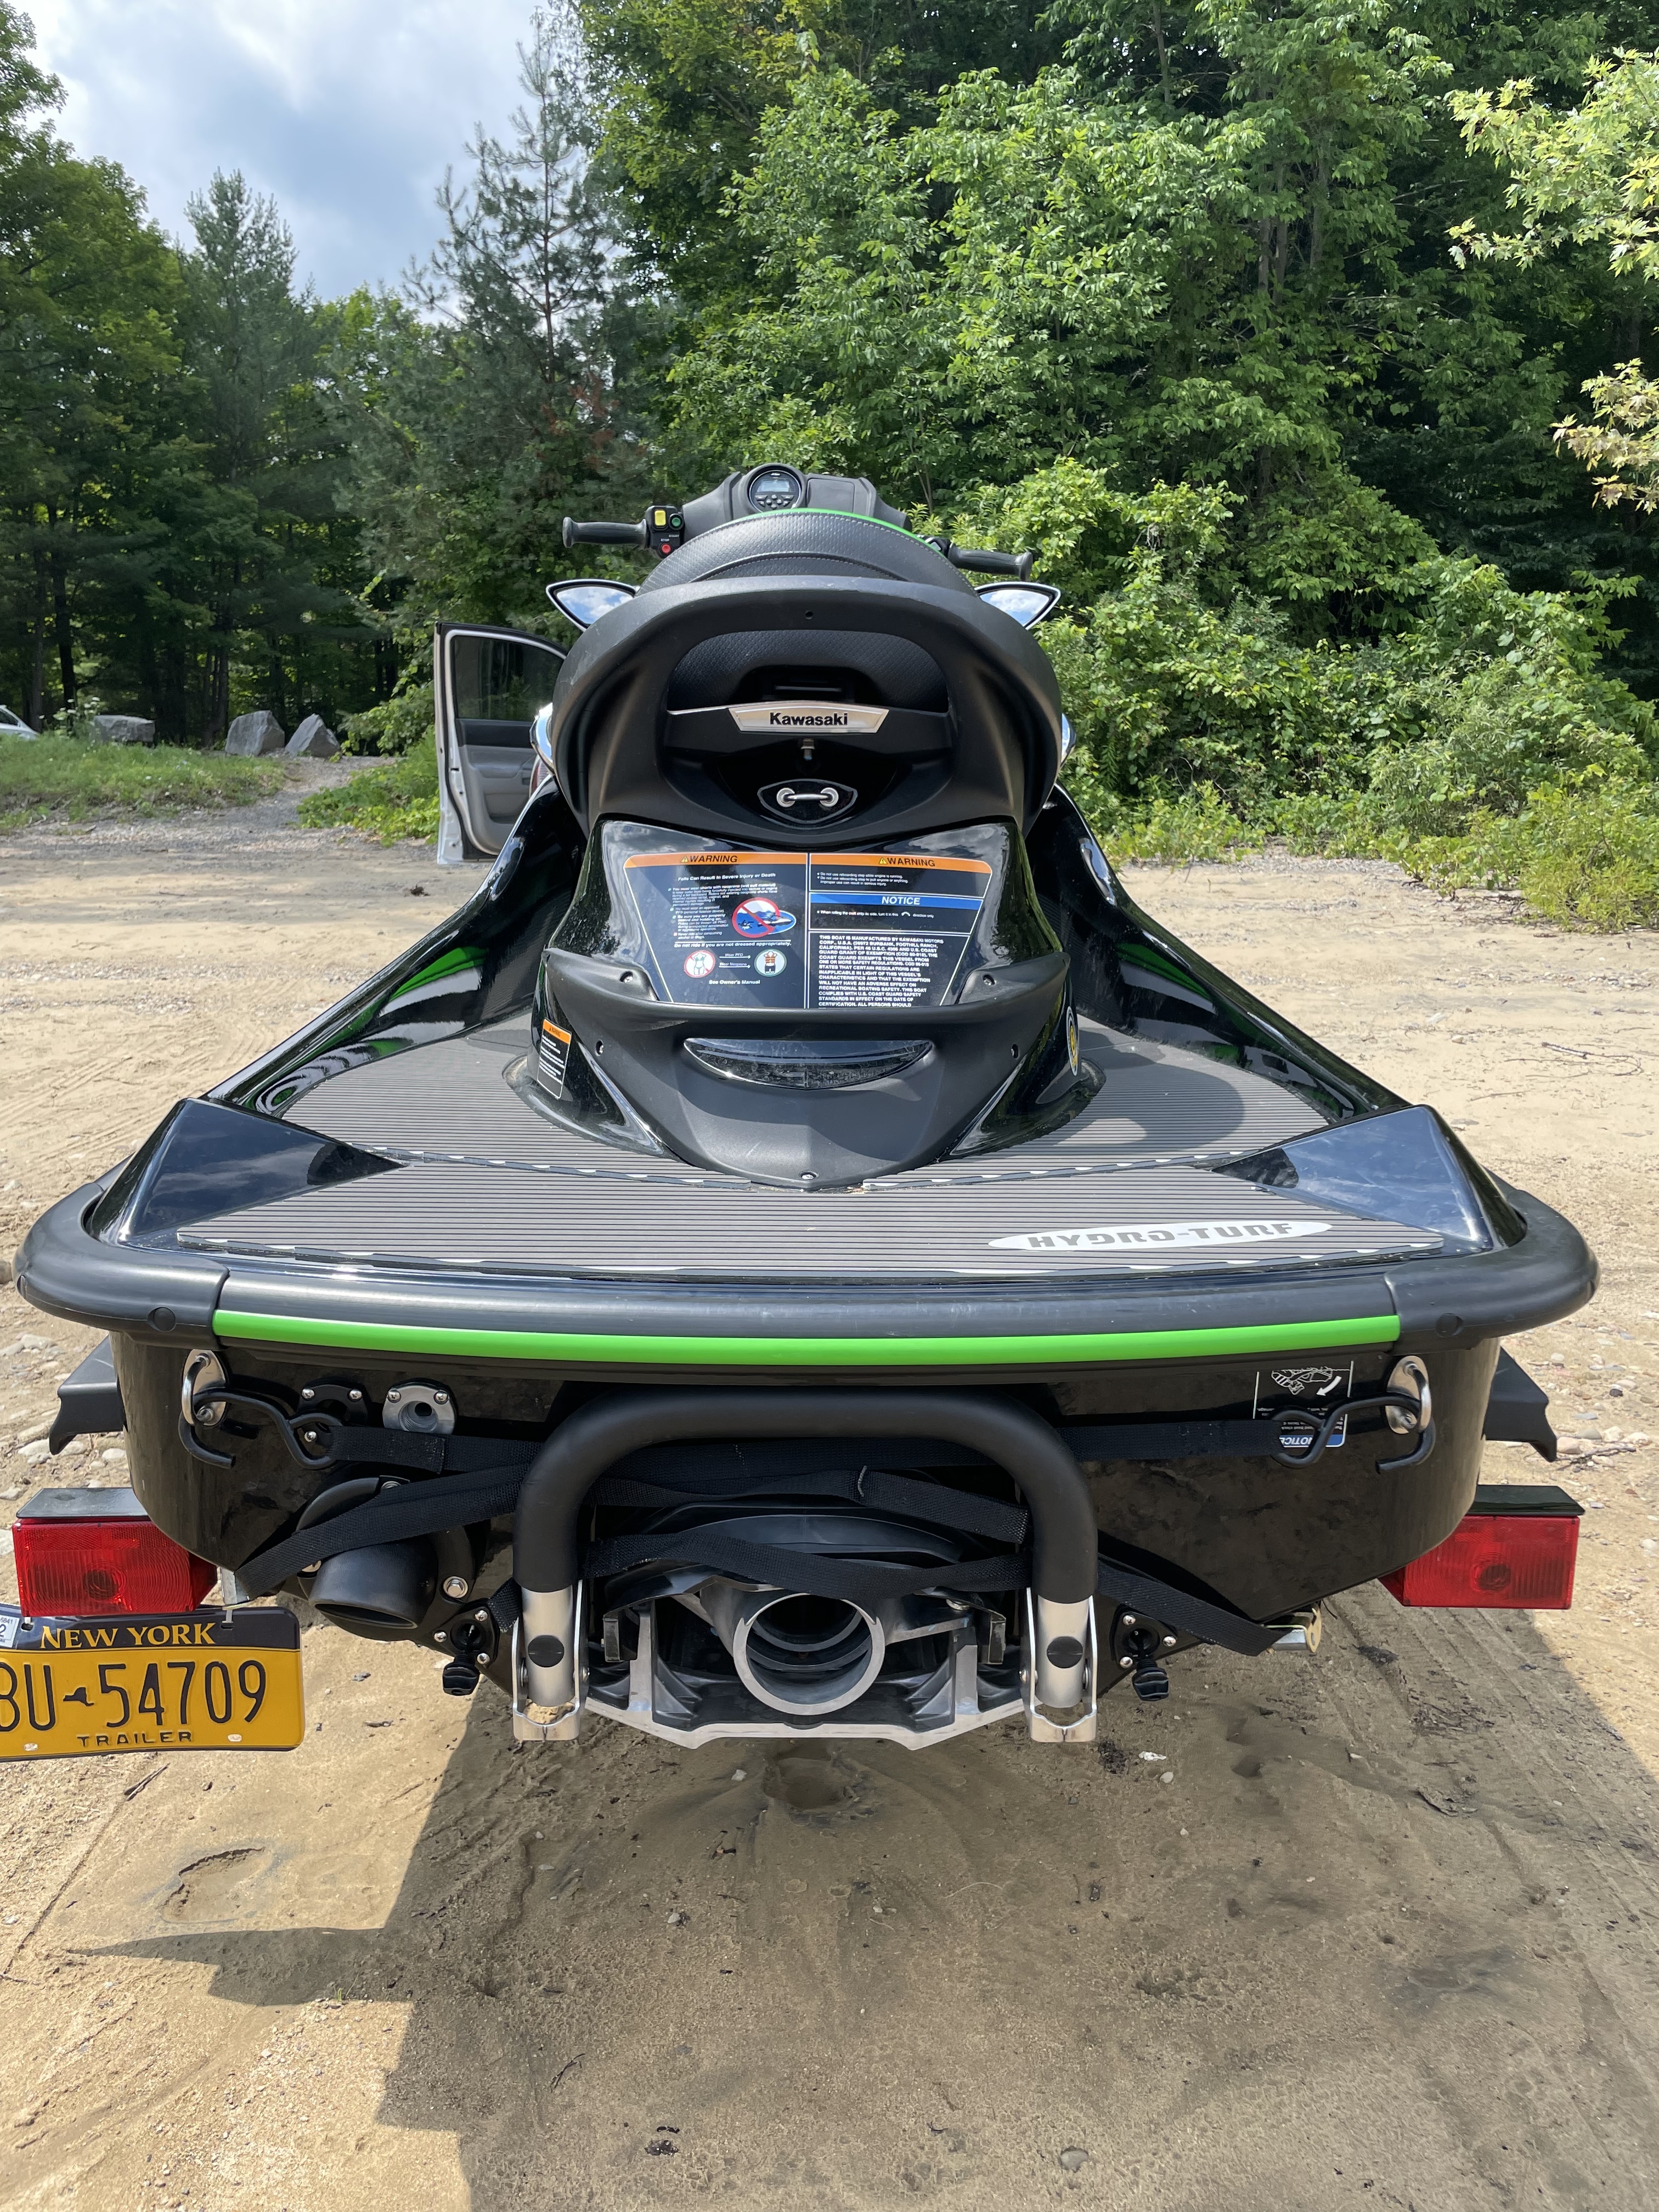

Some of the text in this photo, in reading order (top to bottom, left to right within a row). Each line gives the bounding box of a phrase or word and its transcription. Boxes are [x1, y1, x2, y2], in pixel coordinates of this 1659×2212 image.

[770, 712, 848, 725] Kawasaki
[887, 857, 935, 866] WARNING
[882, 896, 921, 905] NOTICE
[1026, 1222, 1294, 1248] HYDRO-TURF
[40, 1622, 216, 1649] NEW YORK
[98, 1660, 267, 1728] 54709
[77, 1731, 193, 1747] TRAILER
